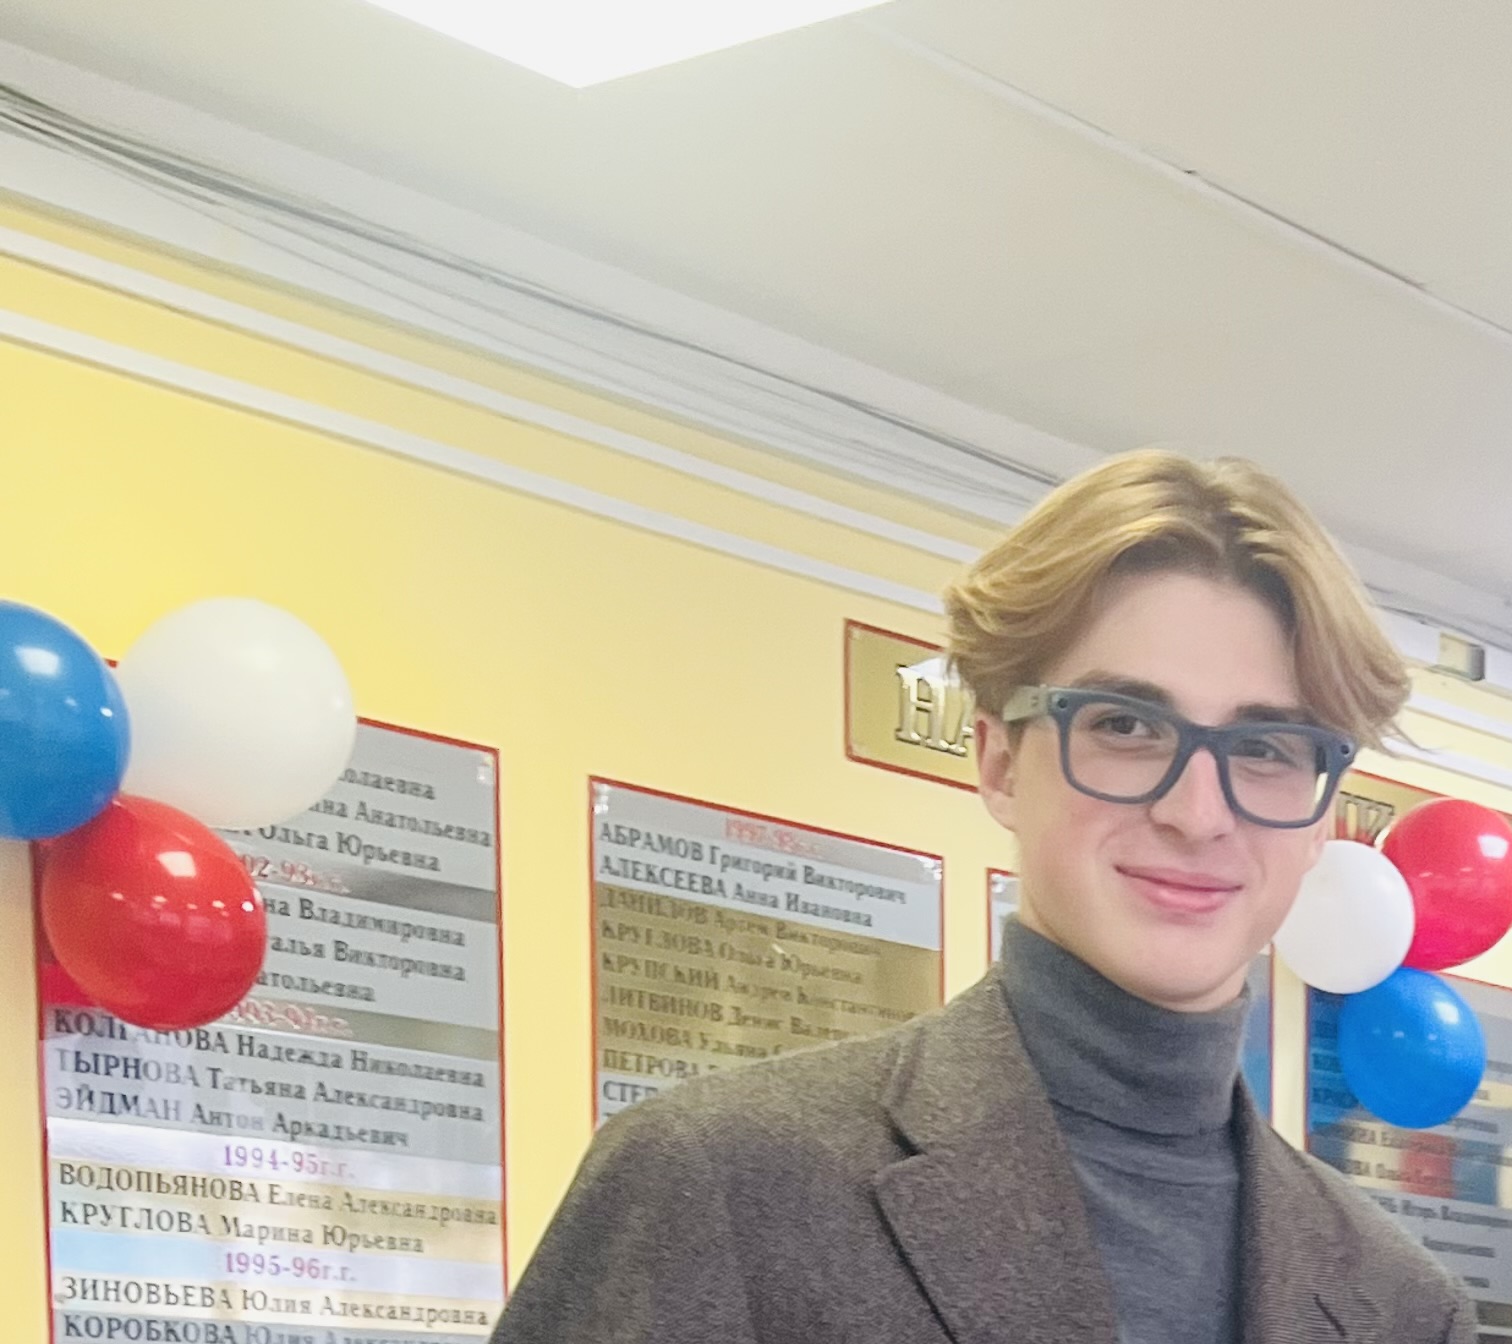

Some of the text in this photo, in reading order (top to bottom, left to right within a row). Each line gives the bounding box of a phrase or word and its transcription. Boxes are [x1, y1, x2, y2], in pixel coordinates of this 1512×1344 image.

[338, 768, 436, 800] олаевна
[355, 800, 492, 847] Анатольевна
[336, 831, 441, 872] Юрьевна
[600, 822, 704, 862] АБРАМОВ
[709, 845, 798, 882] Григорий
[600, 855, 727, 899] АЛЕКСЕЕВА
[733, 882, 779, 909] Анна
[300, 898, 466, 947] Владимировна
[271, 935, 466, 982] алья Викторовна
[256, 970, 376, 1002] атольевна
[55, 1048, 485, 1122] ТЫРНОВА Татьяна Александровна
[237, 1033, 344, 1069] Надежда
[350, 1049, 486, 1088] Николаевна
[56, 1083, 409, 1148] ЭЙДМАН Антон Аркадьевич
[59, 1162, 498, 1228] ВОДОПЬЯНОВА Елена Александровна
[60, 1200, 424, 1253] КРУГЛОВА Марина Юрьевна
[61, 1276, 490, 1328] ЗИНОВЬЕВА Юлия Александровна
